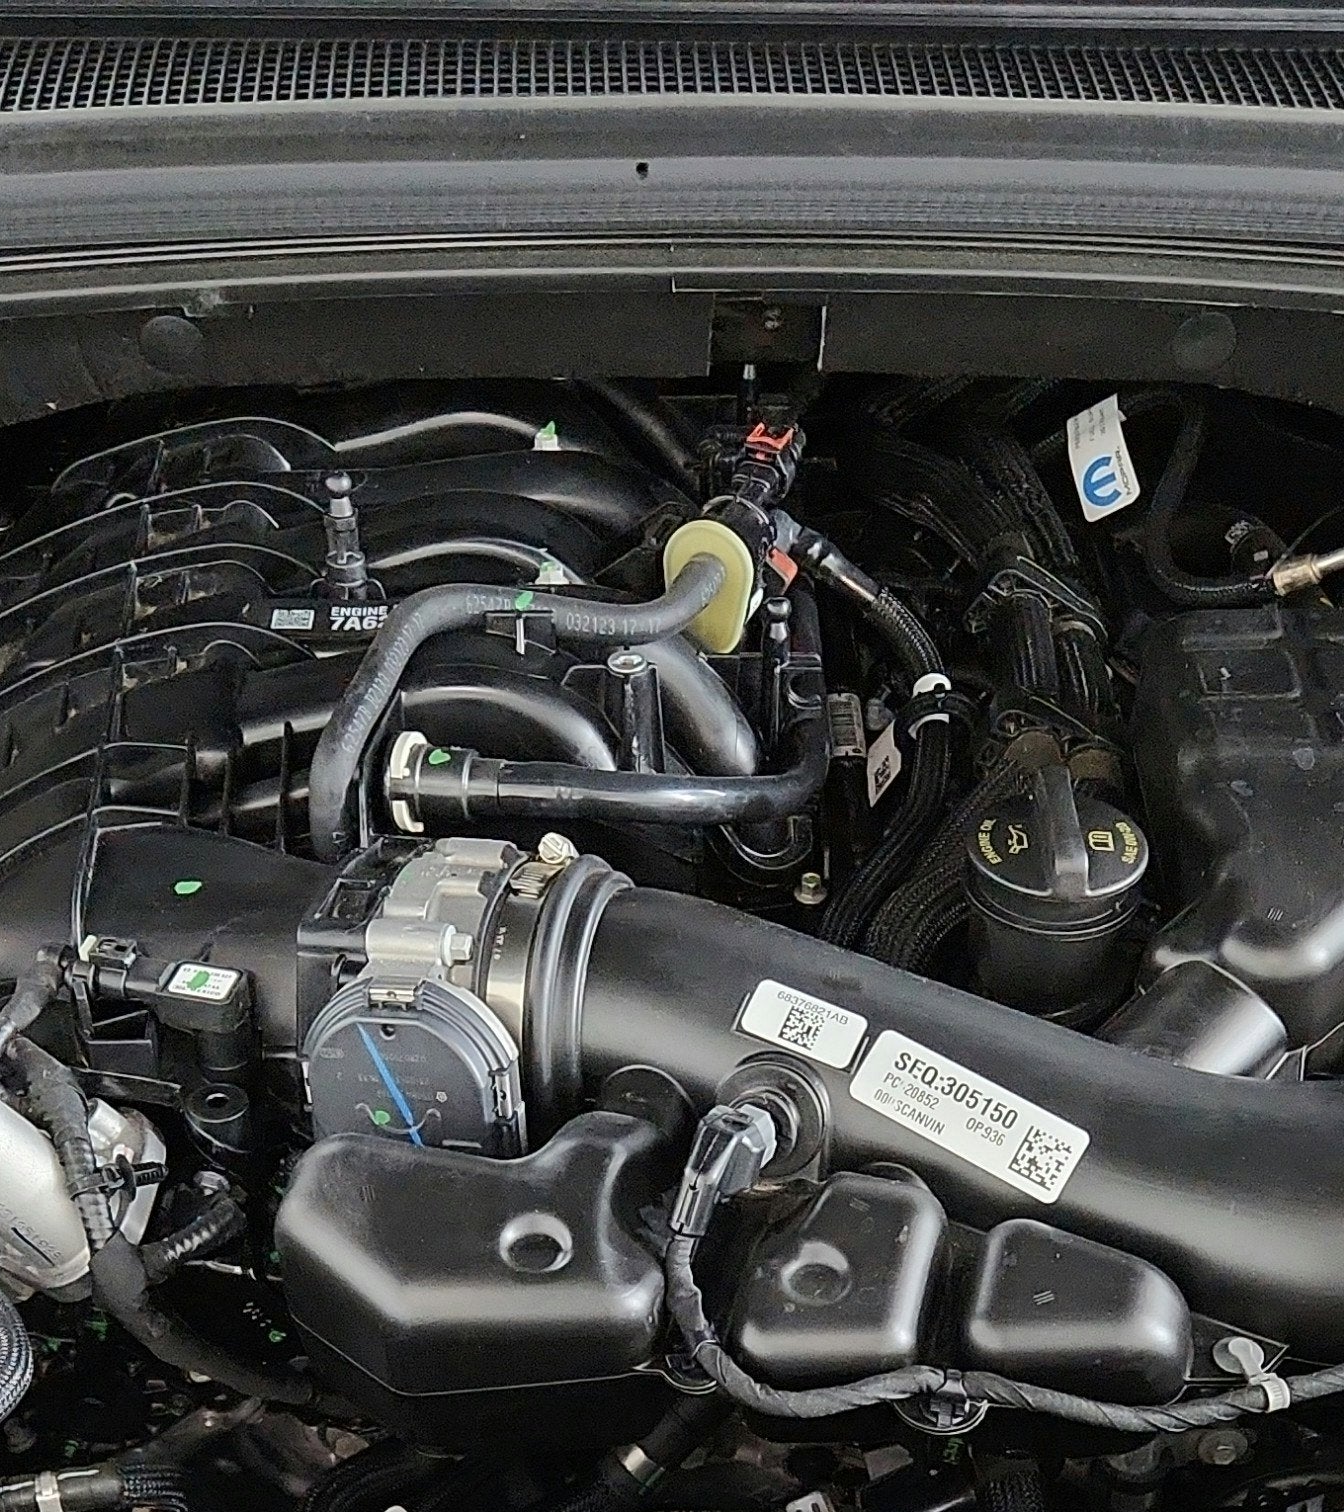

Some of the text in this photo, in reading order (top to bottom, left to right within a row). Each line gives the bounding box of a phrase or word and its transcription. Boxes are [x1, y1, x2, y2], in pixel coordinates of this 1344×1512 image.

[331, 606, 388, 617] ENGINE
[978, 818, 1003, 865] ENGINE OIL
[1121, 845, 1138, 865] SAE
[777, 989, 849, 1026] 68376821AB
[894, 1052, 1019, 1130] SEQ:305150
